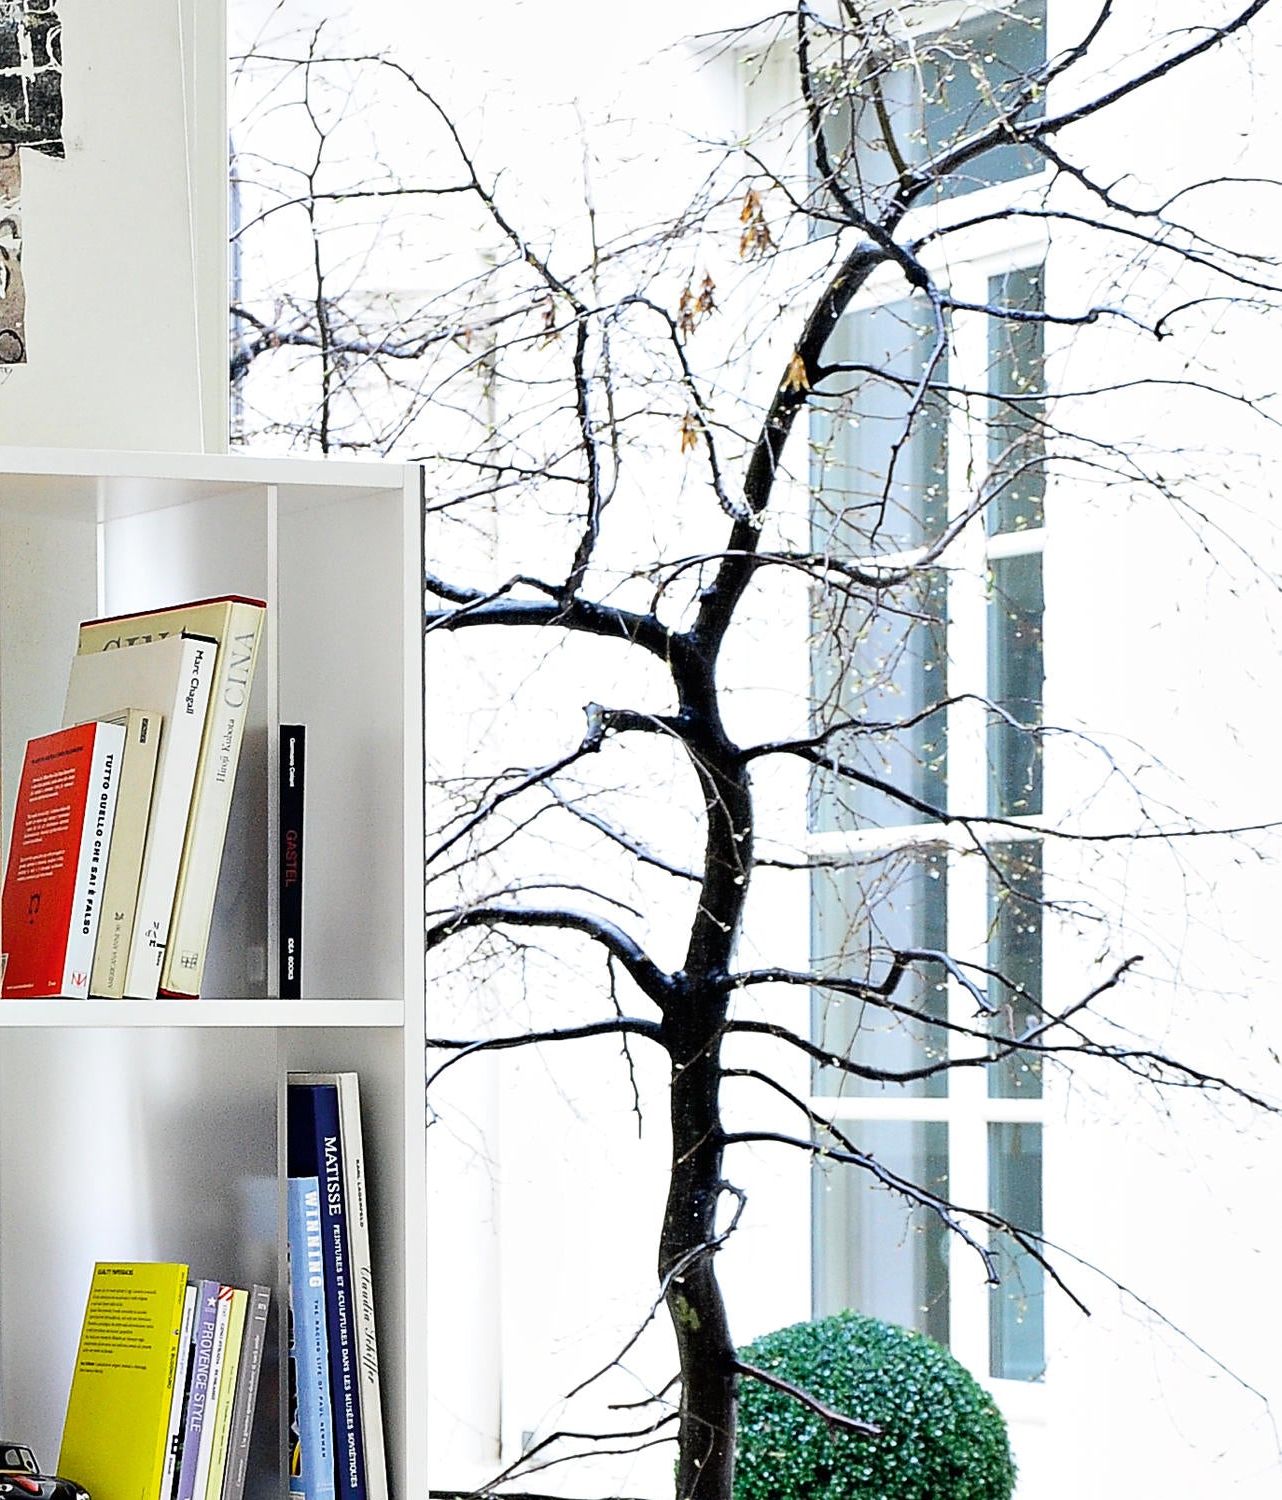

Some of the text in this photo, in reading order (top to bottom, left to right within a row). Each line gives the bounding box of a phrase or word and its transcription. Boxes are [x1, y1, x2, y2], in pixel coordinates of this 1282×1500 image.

[184, 649, 203, 714] Marc Chagall
[215, 629, 254, 782] Hiroji Kubota CINA
[101, 753, 114, 789] TUTTO
[94, 793, 108, 836] QUELLO
[92, 840, 102, 862] CHE
[285, 830, 297, 886] GASTEL
[88, 866, 98, 885] SAI
[81, 898, 93, 934] FALSO
[322, 1136, 342, 1215] MATISSE
[331, 1224, 343, 1272] PEINTURES
[302, 1190, 324, 1288] WINNING
[317, 1380, 323, 1390] OF
[335, 1275, 344, 1287] ET
[358, 1265, 374, 1322] Claudia
[336, 1290, 349, 1345] SCULPTURES
[194, 1321, 214, 1389] PROVENCE
[340, 1348, 350, 1371] DANS
[361, 1328, 378, 1384] Schiffer
[342, 1374, 352, 1390] LES
[189, 1392, 205, 1432] STYLE
[343, 1393, 355, 1429] MUSÉES
